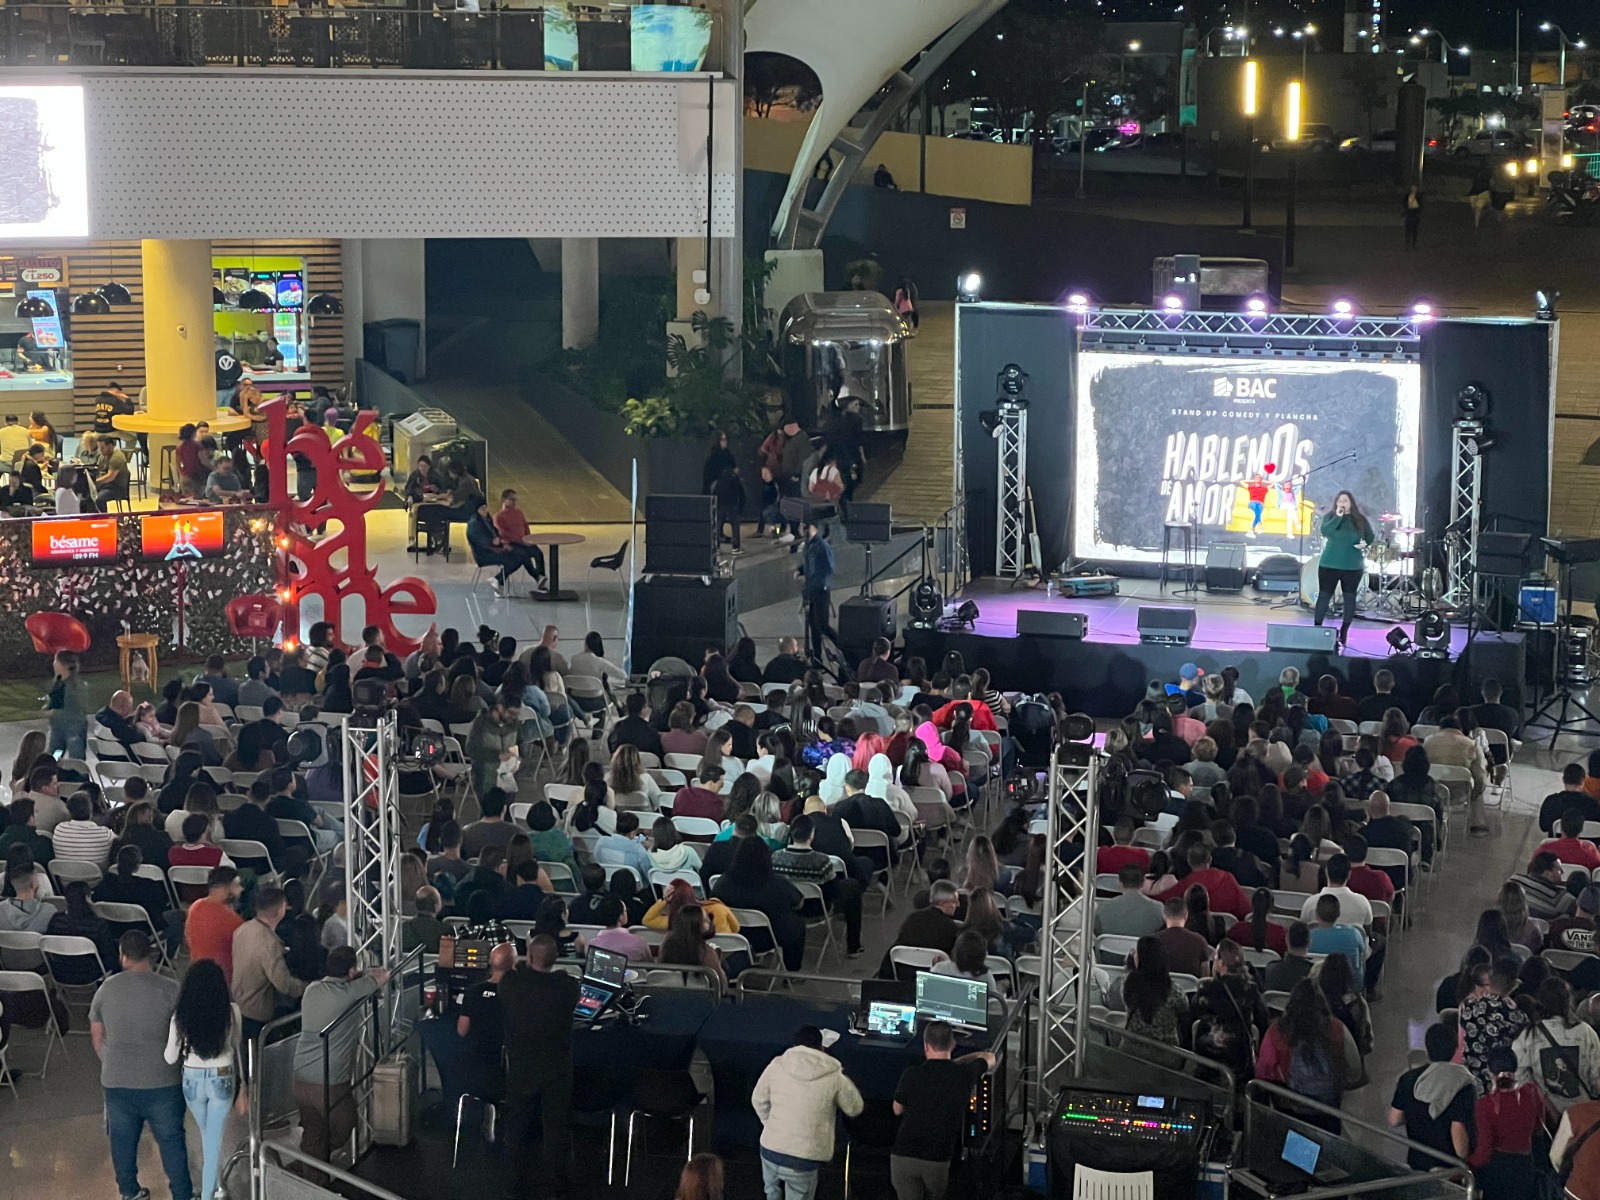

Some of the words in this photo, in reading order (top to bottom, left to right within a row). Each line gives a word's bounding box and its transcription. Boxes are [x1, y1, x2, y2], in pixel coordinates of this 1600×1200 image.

[1236, 377, 1277, 398] BAC
[1275, 413, 1318, 421] PLANCHA
[1163, 422, 1314, 485] HABLEMOS
[1160, 480, 1172, 495] DE
[1165, 480, 1237, 525] AMOR
[50, 535, 99, 549] bésame
[1566, 930, 1593, 941] VANS
